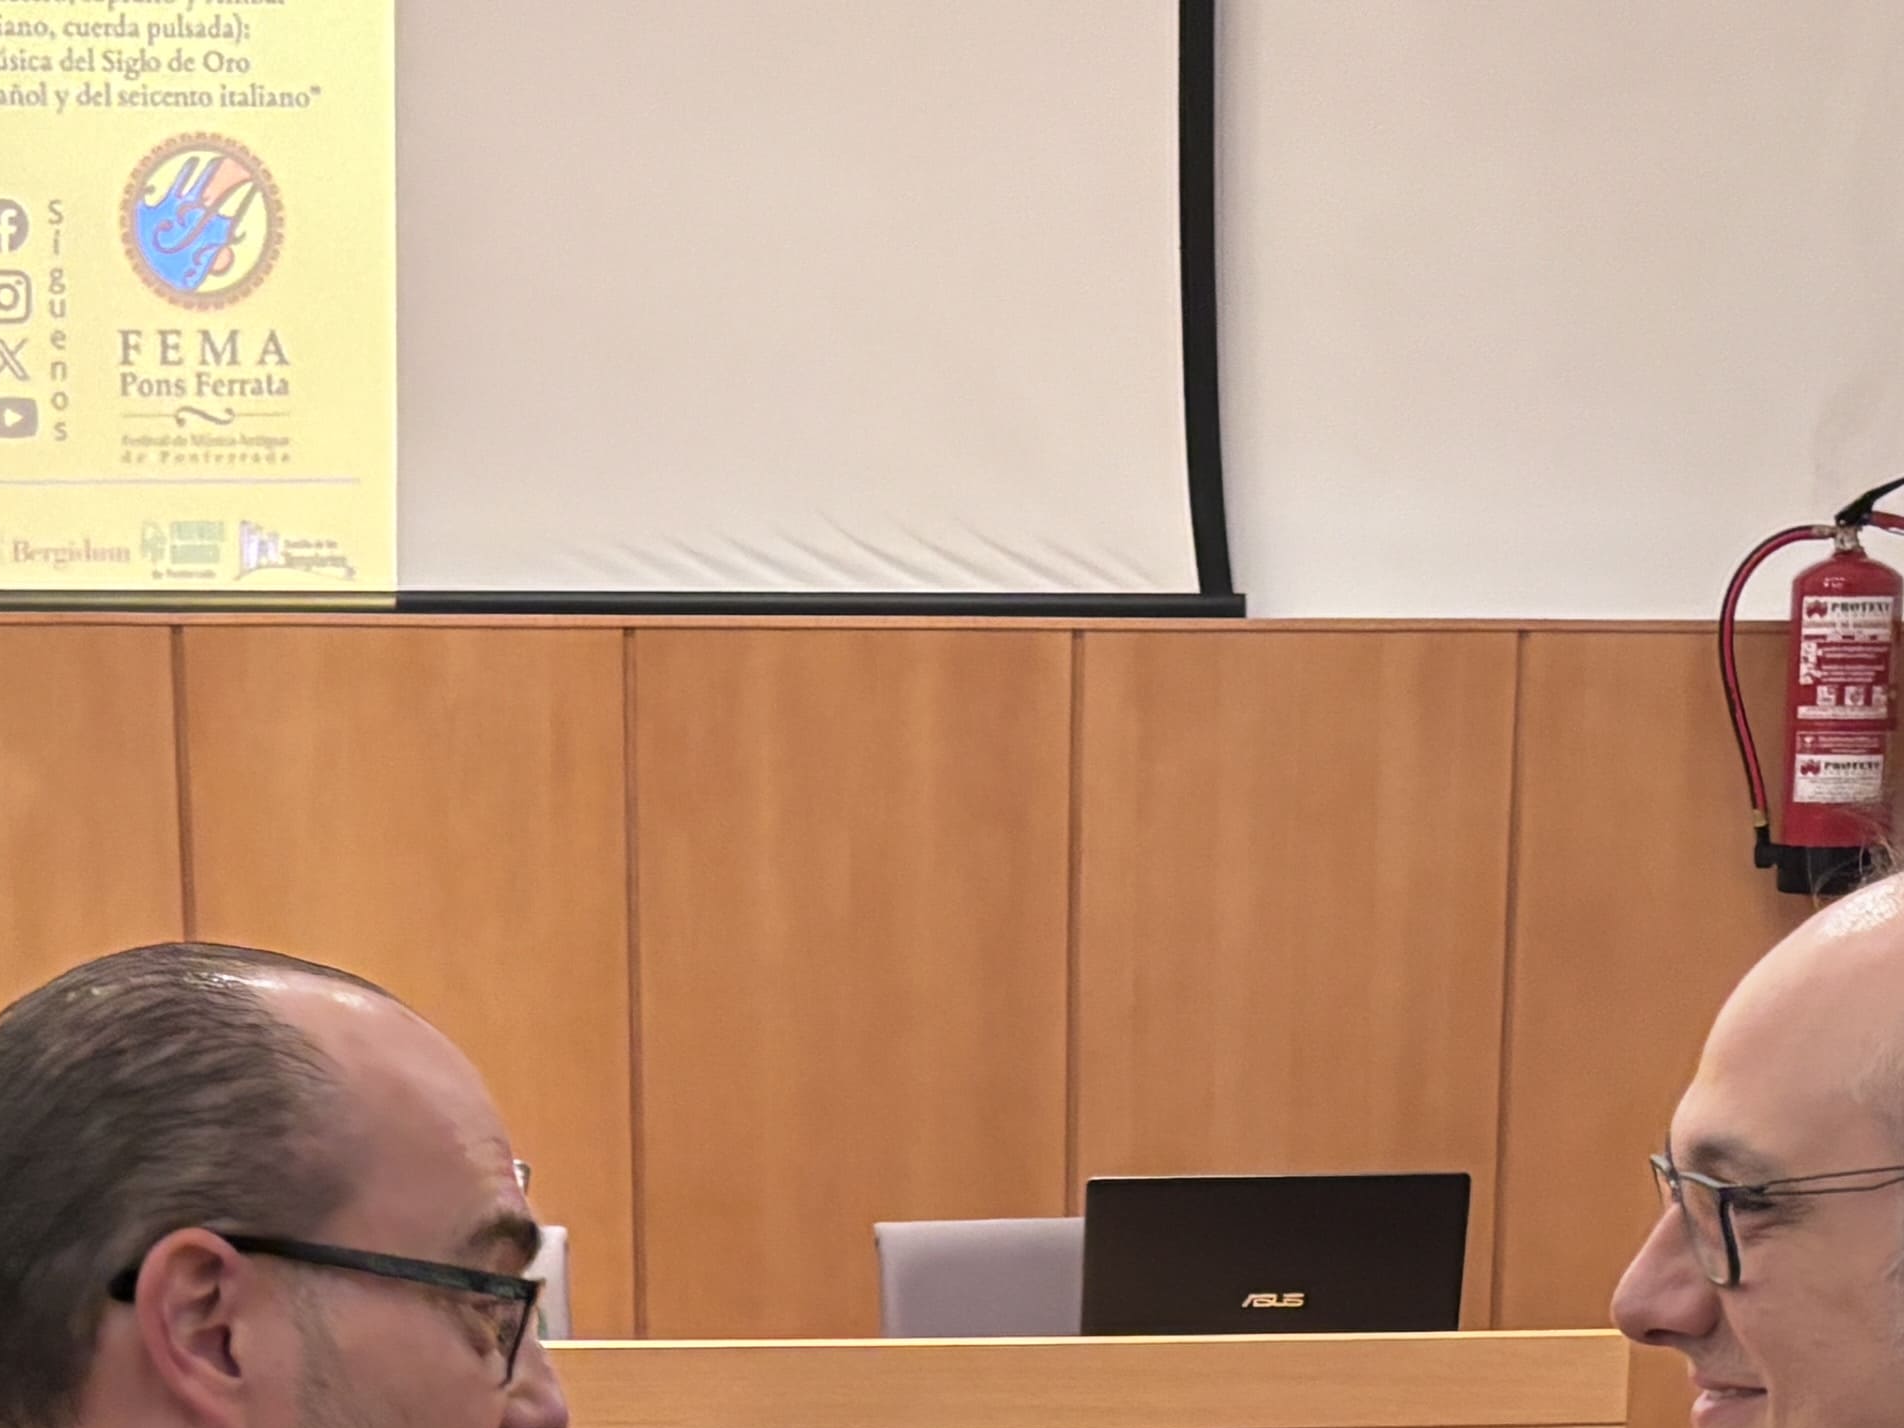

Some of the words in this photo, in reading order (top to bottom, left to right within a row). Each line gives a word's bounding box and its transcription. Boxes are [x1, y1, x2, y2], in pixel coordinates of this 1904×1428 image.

[63, 12, 140, 38] cuerda
[147, 12, 250, 46] pulsada):
[59, 48, 94, 73] del
[101, 47, 161, 80] Siglo
[167, 48, 195, 73] de
[202, 50, 251, 74] Oro
[54, 88, 69, 113] y
[76, 81, 112, 108] del
[117, 84, 213, 108] seicento
[118, 329, 291, 368] FEMA
[119, 371, 187, 398] Pons
[195, 371, 290, 398] Ferrata
[1241, 1292, 1305, 1309] ASUS
